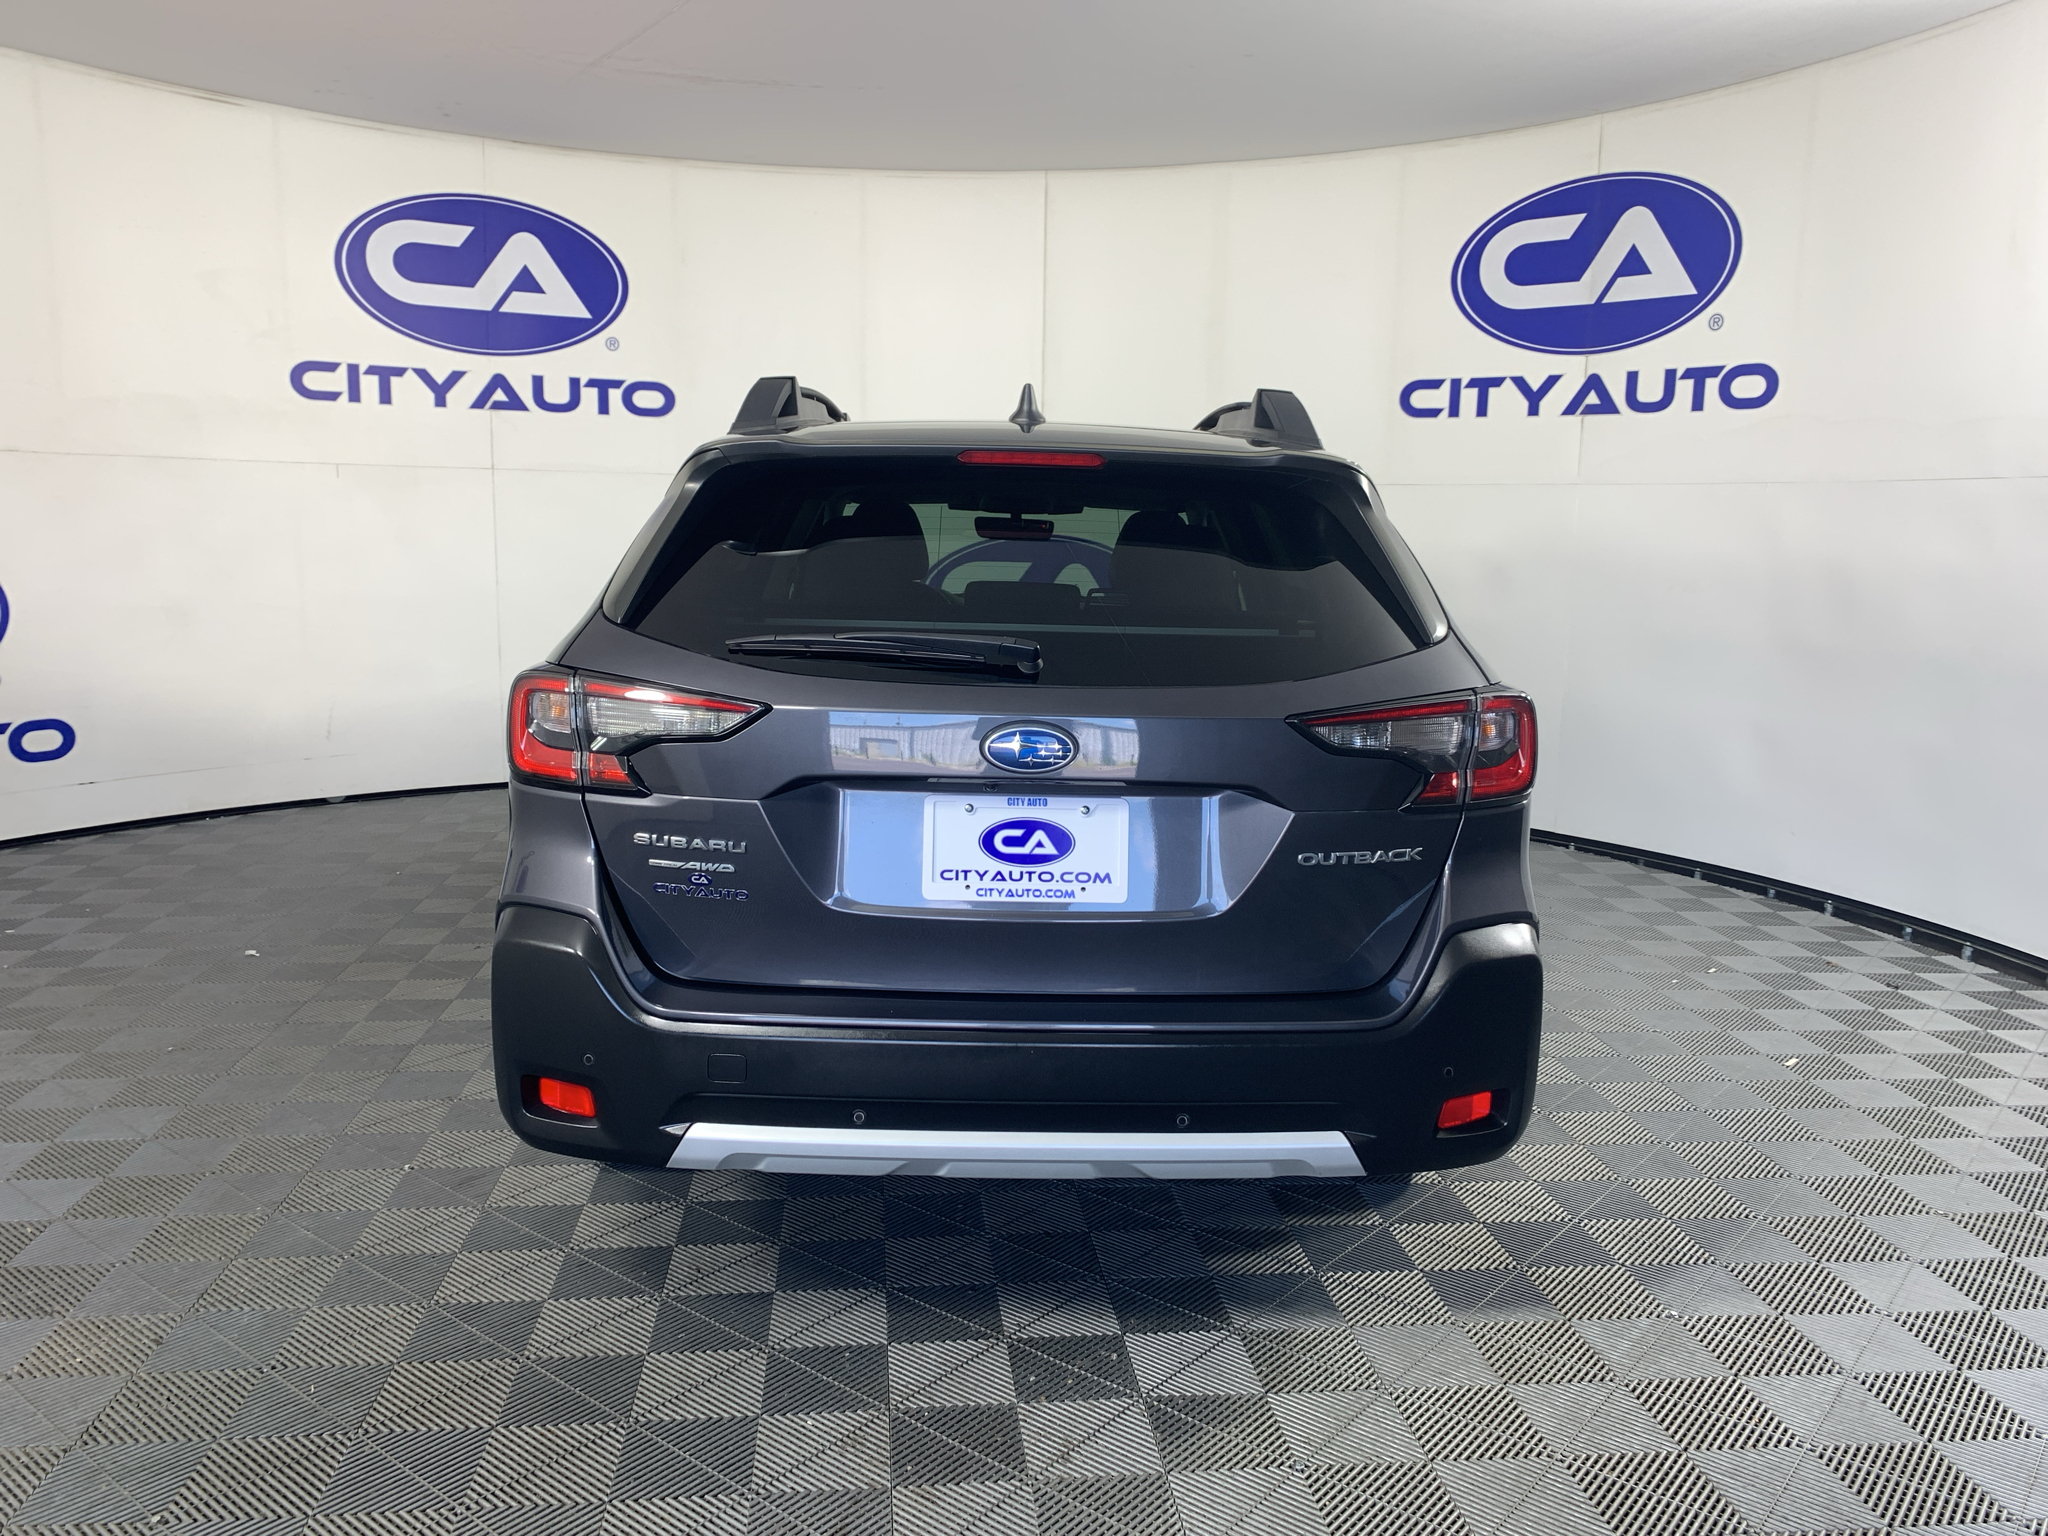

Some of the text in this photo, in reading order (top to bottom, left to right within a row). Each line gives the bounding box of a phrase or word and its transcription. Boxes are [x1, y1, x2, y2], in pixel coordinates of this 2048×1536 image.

[1479, 205, 1699, 310] CA
[365, 219, 594, 319] CA
[1007, 797, 1048, 807] CITY AUTO
[633, 832, 748, 854] SUBARU
[993, 828, 1060, 855] CA
[1297, 847, 1423, 866] OUTBACK
[681, 861, 735, 873] AWD
[691, 875, 709, 884] CA
[939, 869, 1112, 884] CITYAUTO.COM
[975, 887, 1076, 899] CITYAUTO.COM
